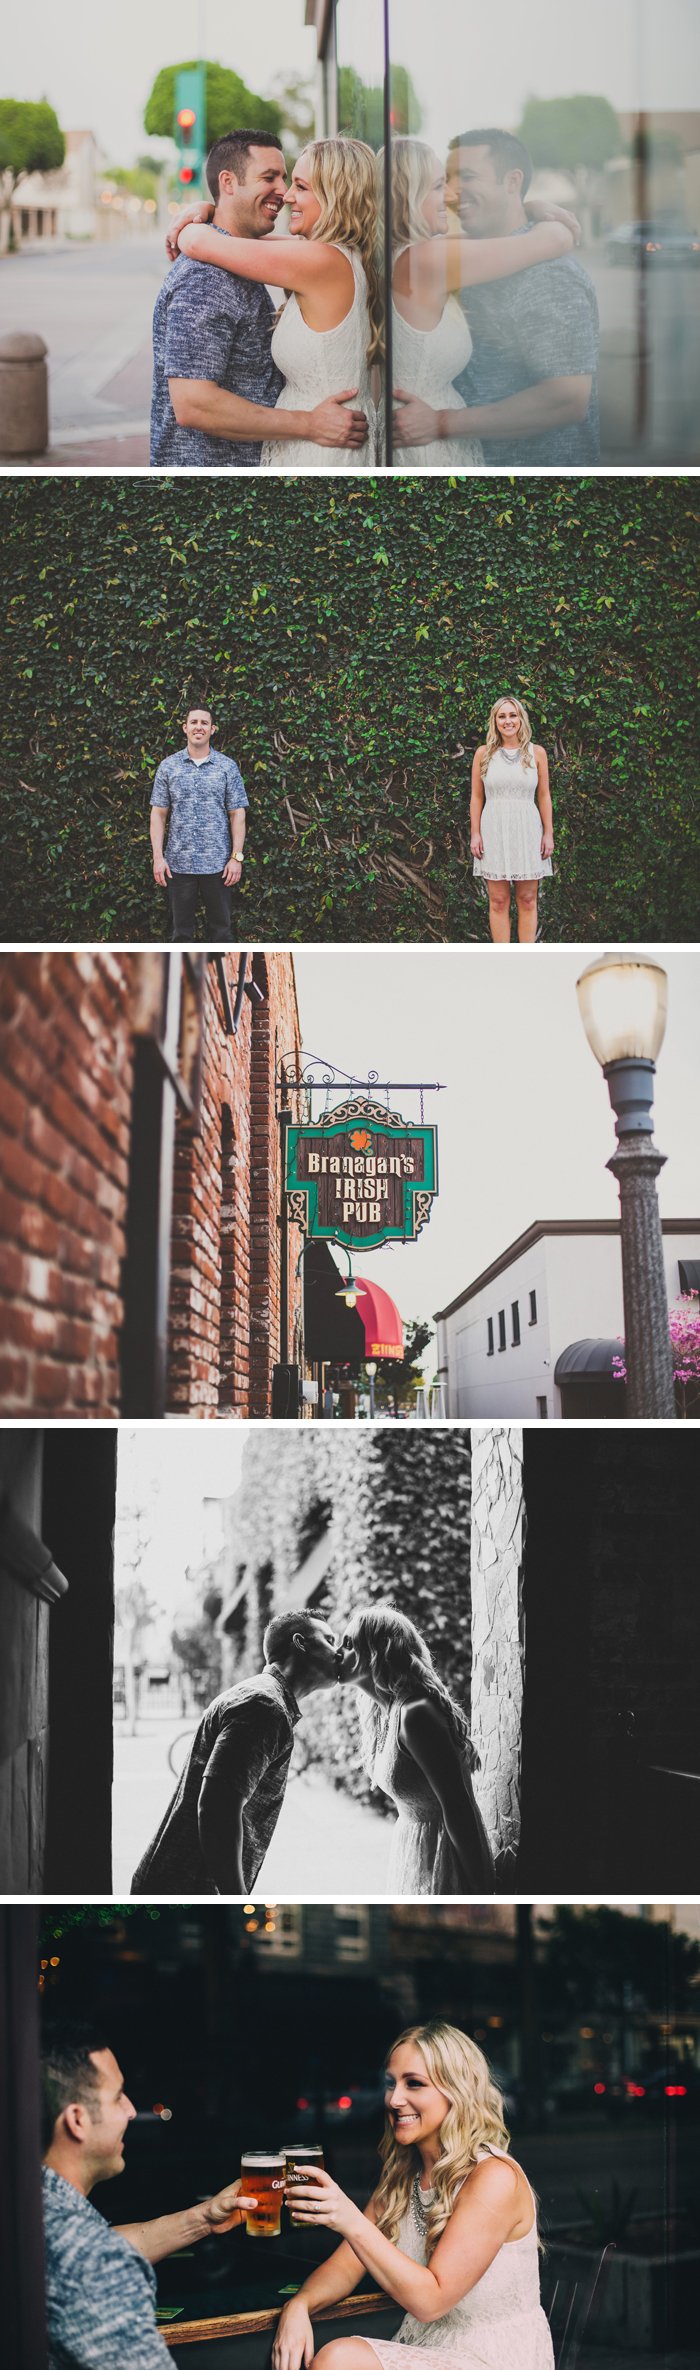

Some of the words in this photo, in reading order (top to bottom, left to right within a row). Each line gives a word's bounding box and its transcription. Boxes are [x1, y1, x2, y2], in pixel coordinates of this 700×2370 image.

[308, 1153, 414, 1177] Branagan's
[336, 1178, 388, 1201] IRISH
[342, 1202, 381, 1222] PUB
